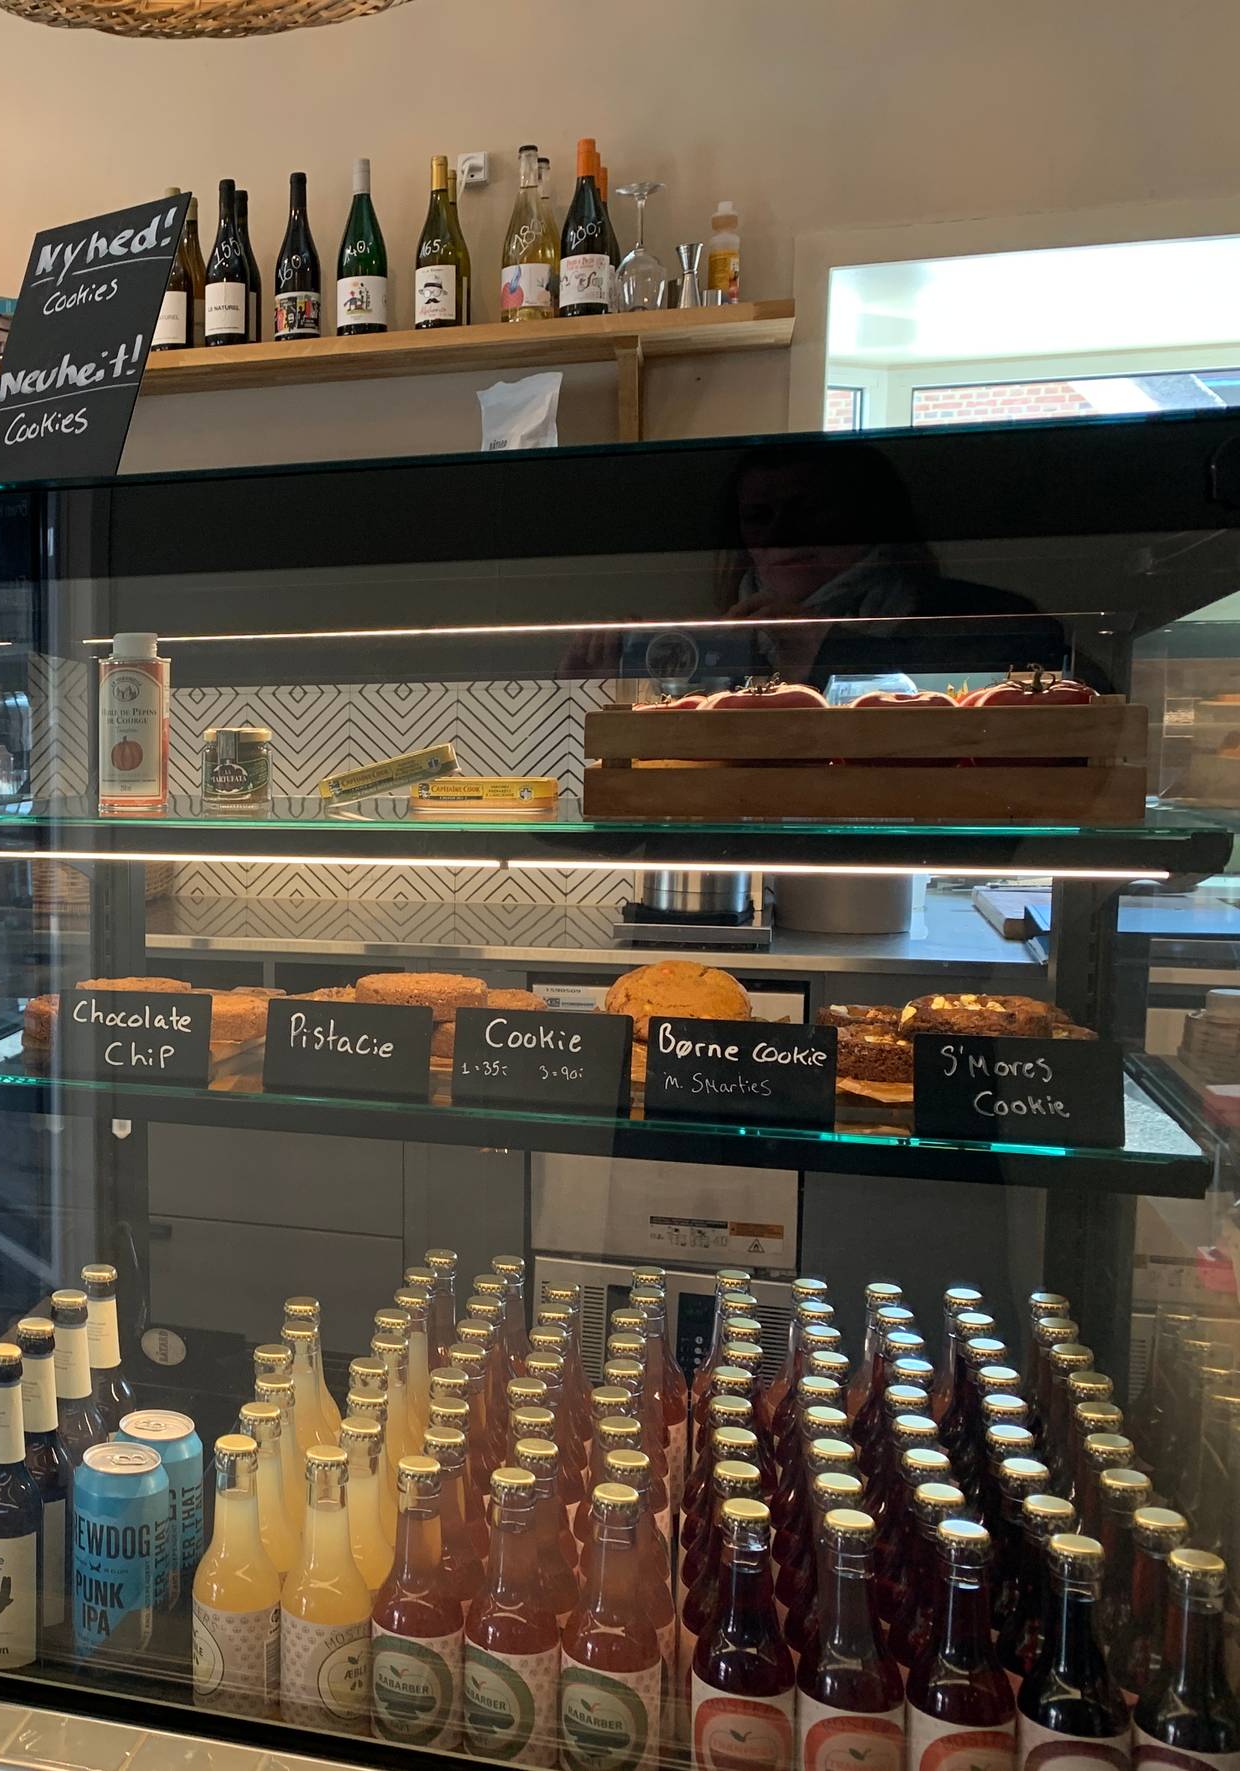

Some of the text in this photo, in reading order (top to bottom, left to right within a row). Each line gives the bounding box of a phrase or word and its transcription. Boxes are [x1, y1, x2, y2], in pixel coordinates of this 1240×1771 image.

[35, 206, 177, 286] Nyhed!
[43, 278, 118, 315] Cookies
[4, 407, 88, 445] Cookies
[463, 784, 480, 793] COOK
[73, 1000, 193, 1033] Chocolate
[485, 1018, 581, 1052] Cookie
[290, 1013, 394, 1059] Pistacie
[659, 1022, 739, 1061] Børne
[974, 1091, 1070, 1118] Cookie
[76, 1569, 125, 1609] PUNK
[82, 1602, 110, 1637] IPA
